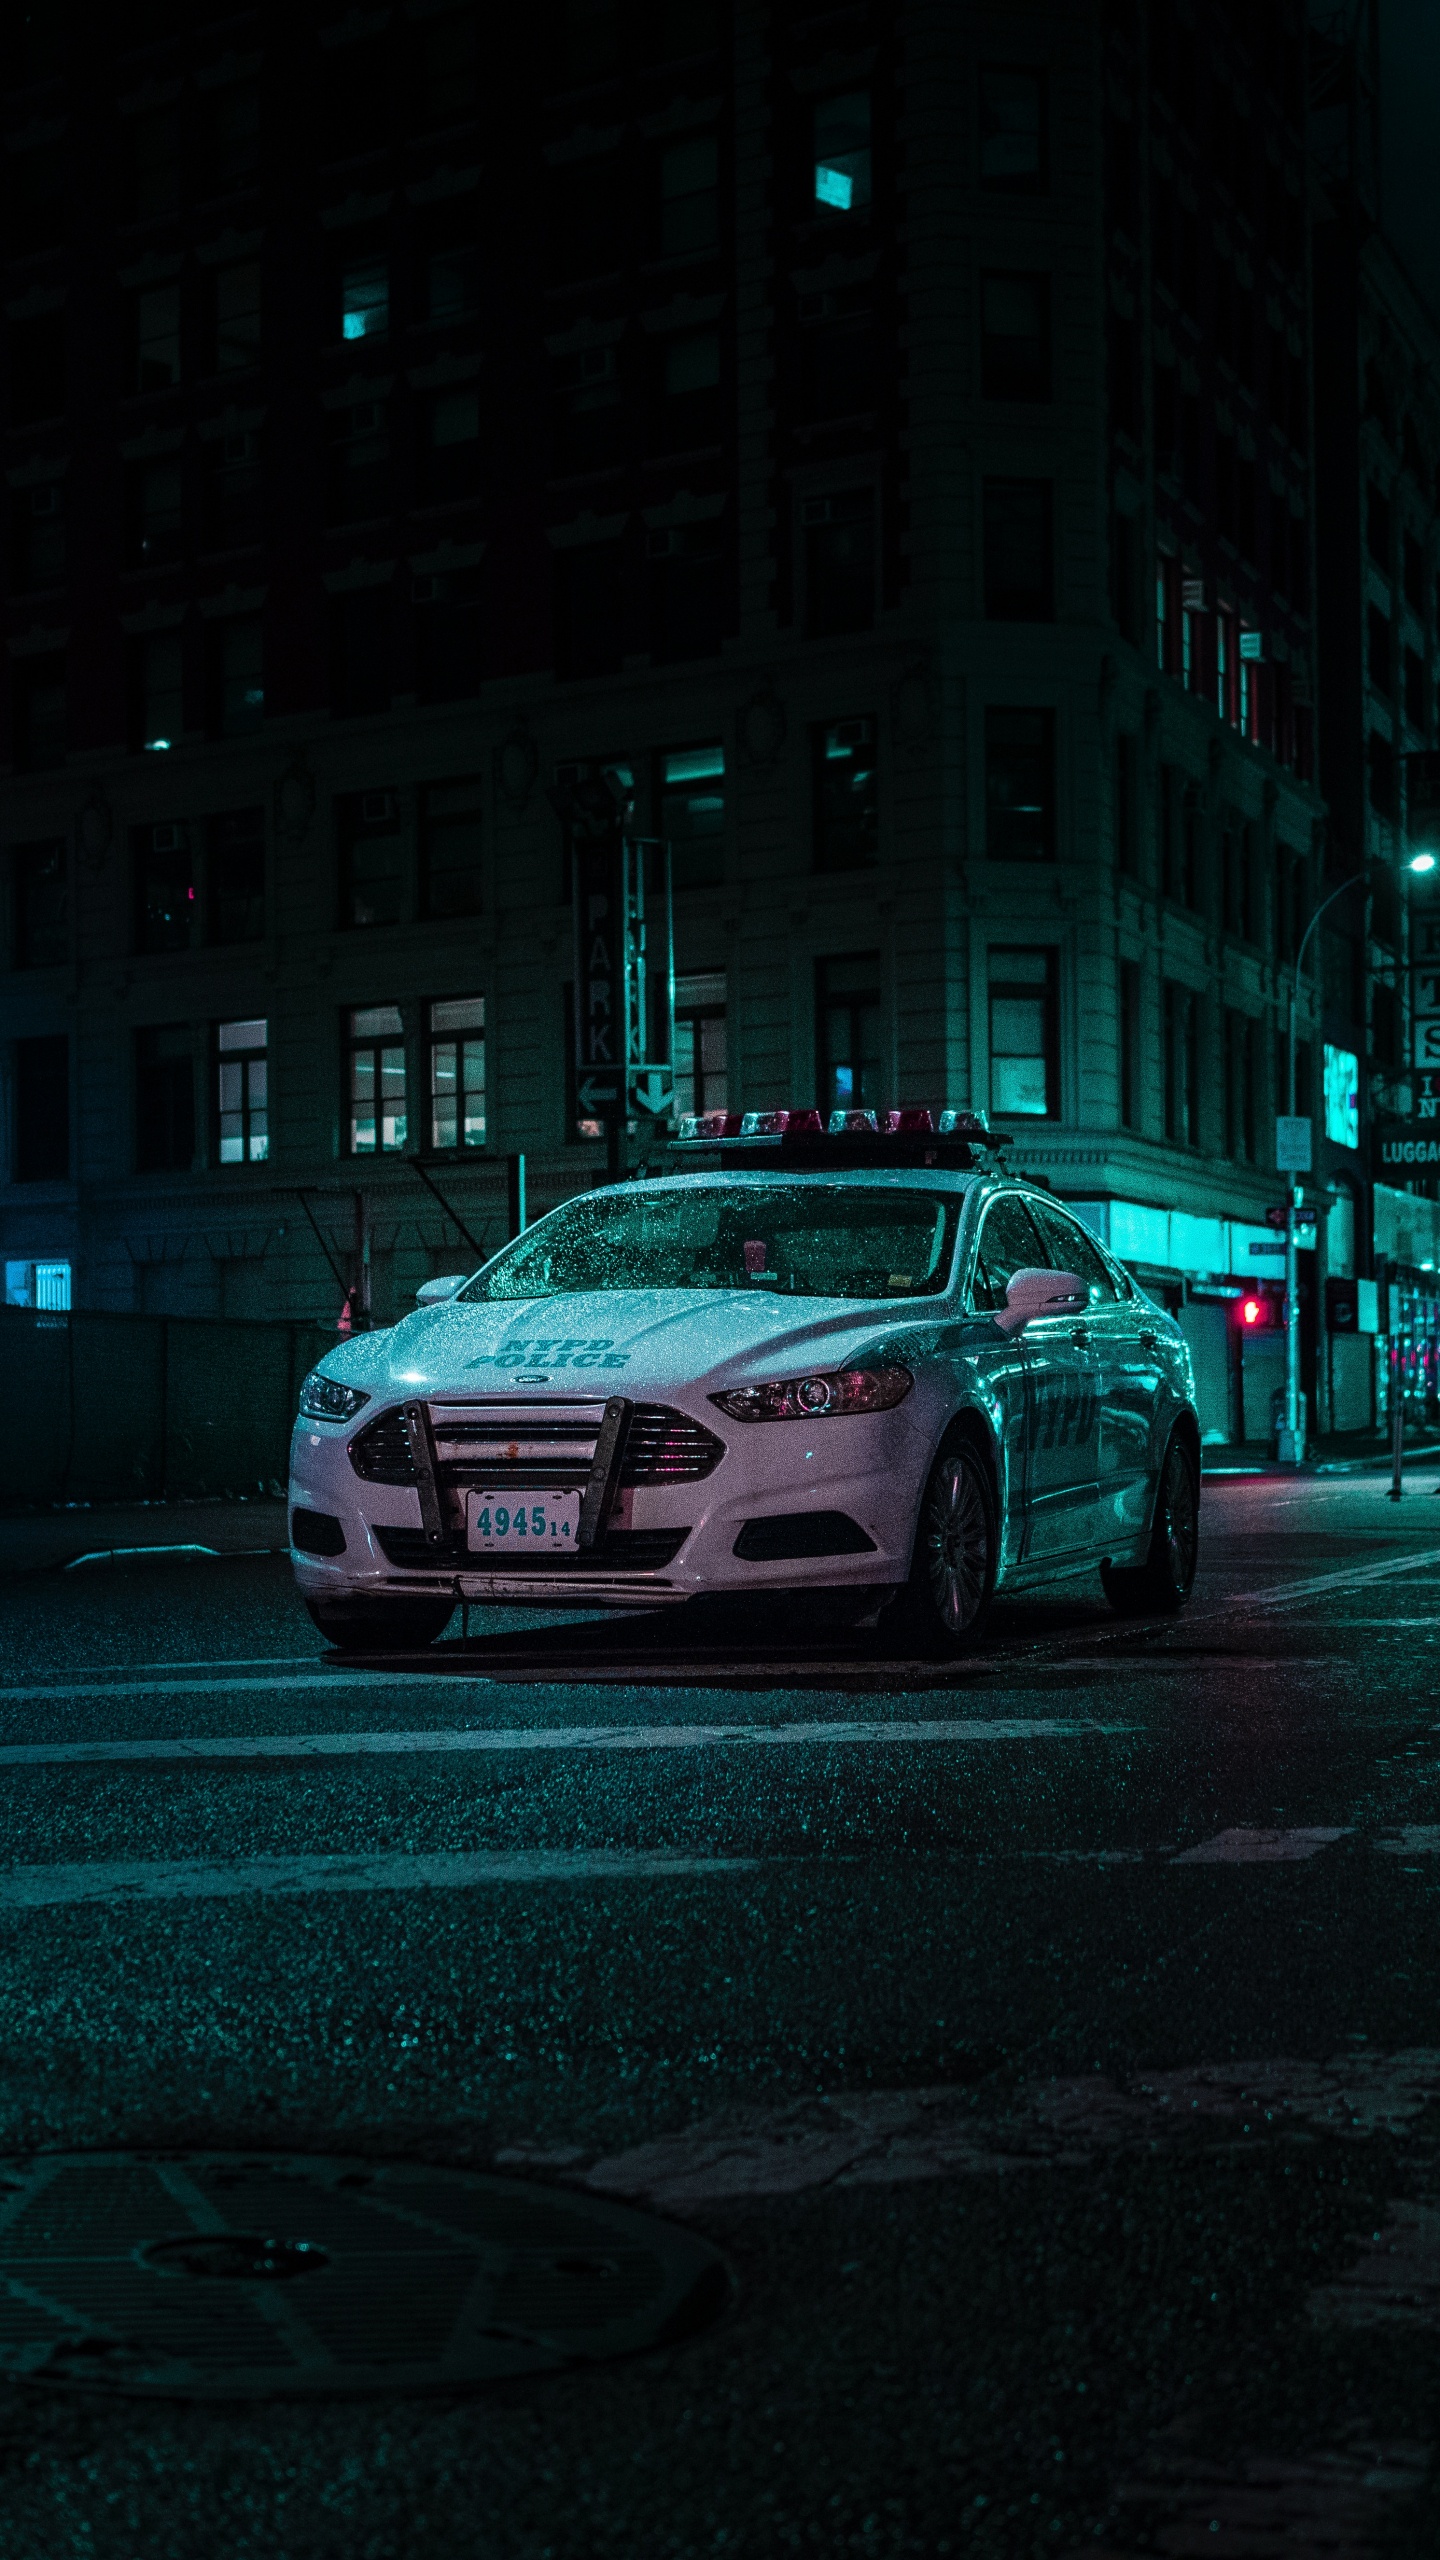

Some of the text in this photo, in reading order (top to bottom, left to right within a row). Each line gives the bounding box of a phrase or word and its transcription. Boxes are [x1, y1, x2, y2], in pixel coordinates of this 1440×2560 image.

[588, 895, 612, 1062] PARK
[1381, 1140, 1440, 1164] LUGGA
[498, 1339, 615, 1352] NYPD
[463, 1353, 631, 1368] POLICE
[477, 1507, 570, 1536] 4945 14
